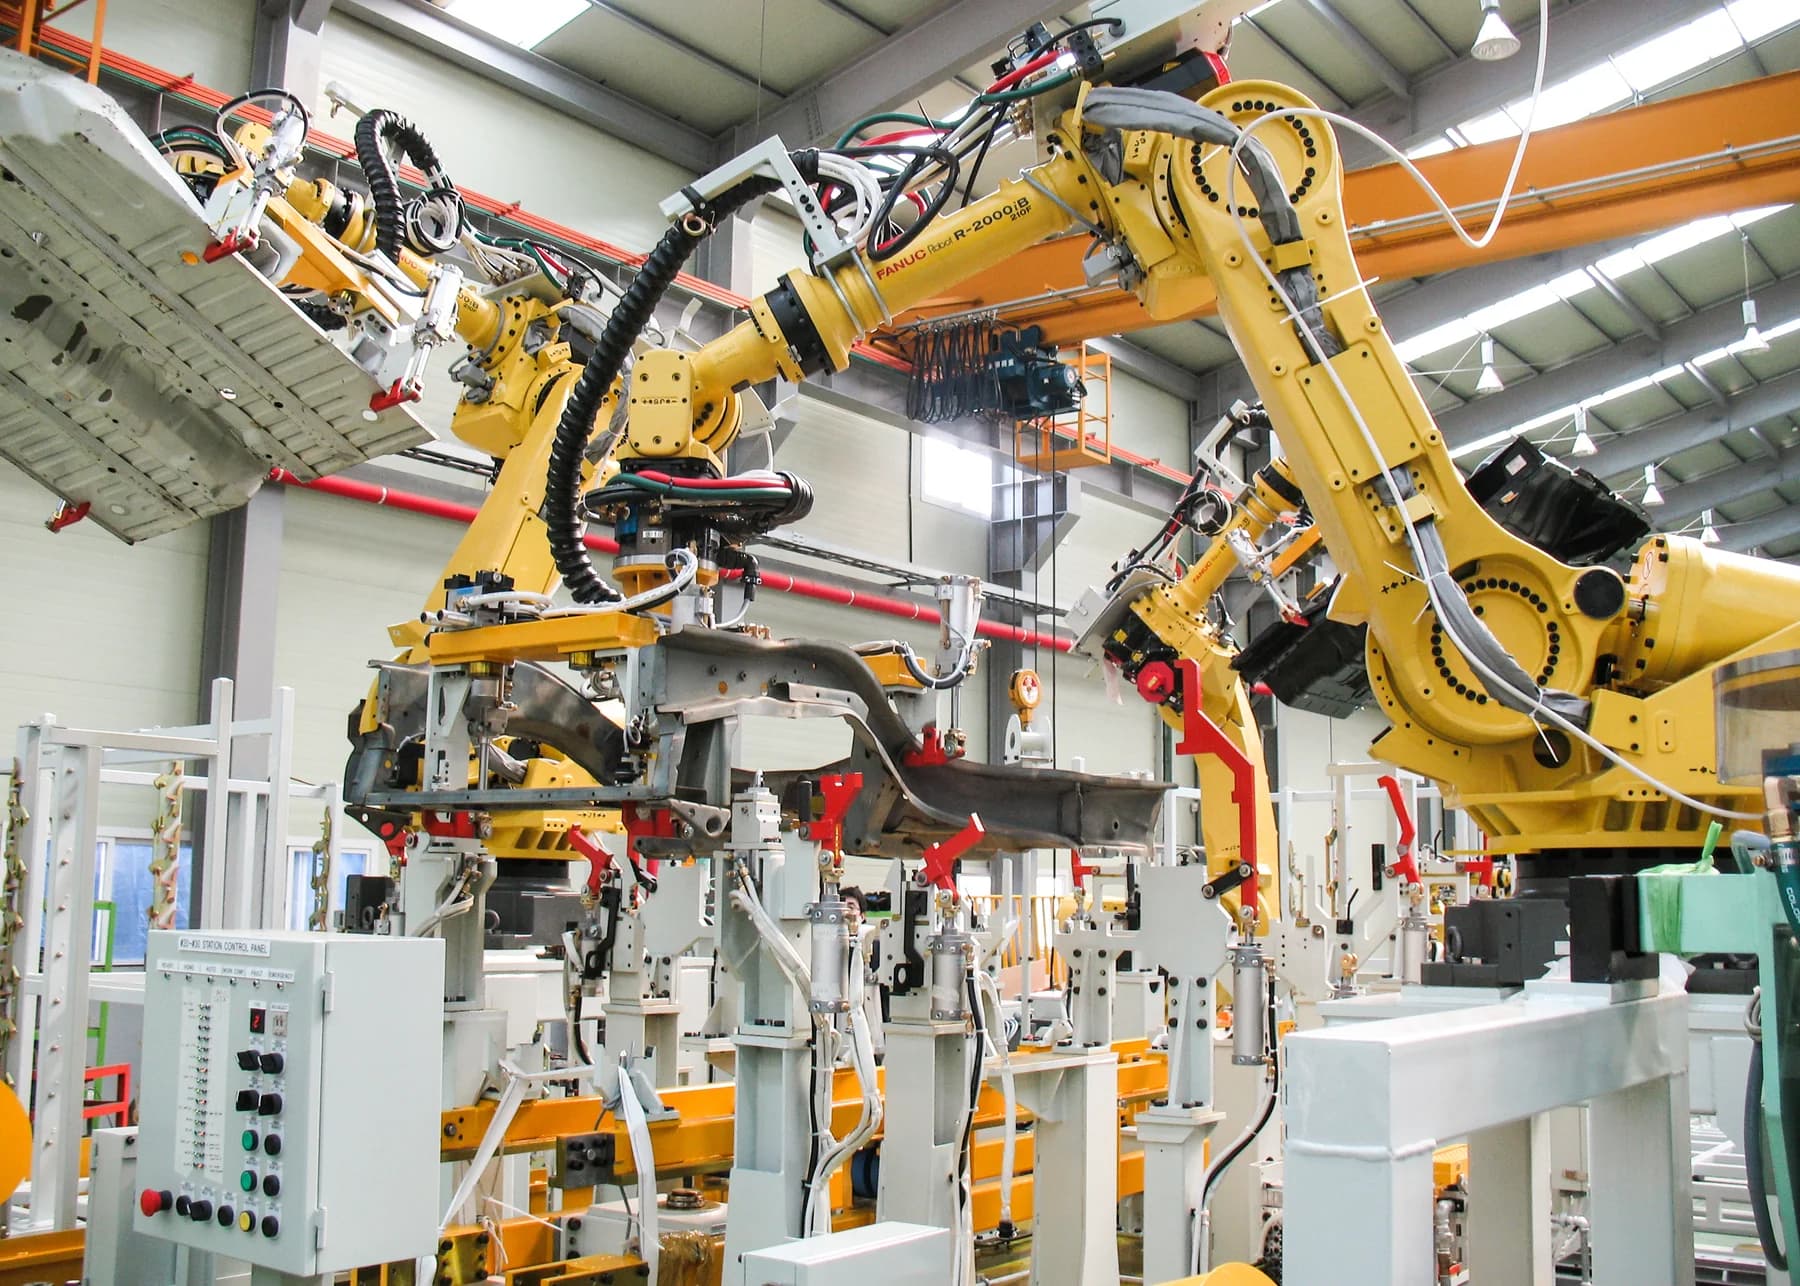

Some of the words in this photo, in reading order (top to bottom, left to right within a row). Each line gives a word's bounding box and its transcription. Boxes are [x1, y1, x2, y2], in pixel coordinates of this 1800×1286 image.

[1009, 205, 1032, 221] 210F
[876, 249, 926, 280] FANUC
[927, 236, 953, 254] Robot
[953, 196, 1030, 241] R-2000iB
[401, 256, 417, 269] NUC
[224, 942, 249, 953] CONTROL
[250, 943, 268, 953] PANEL
